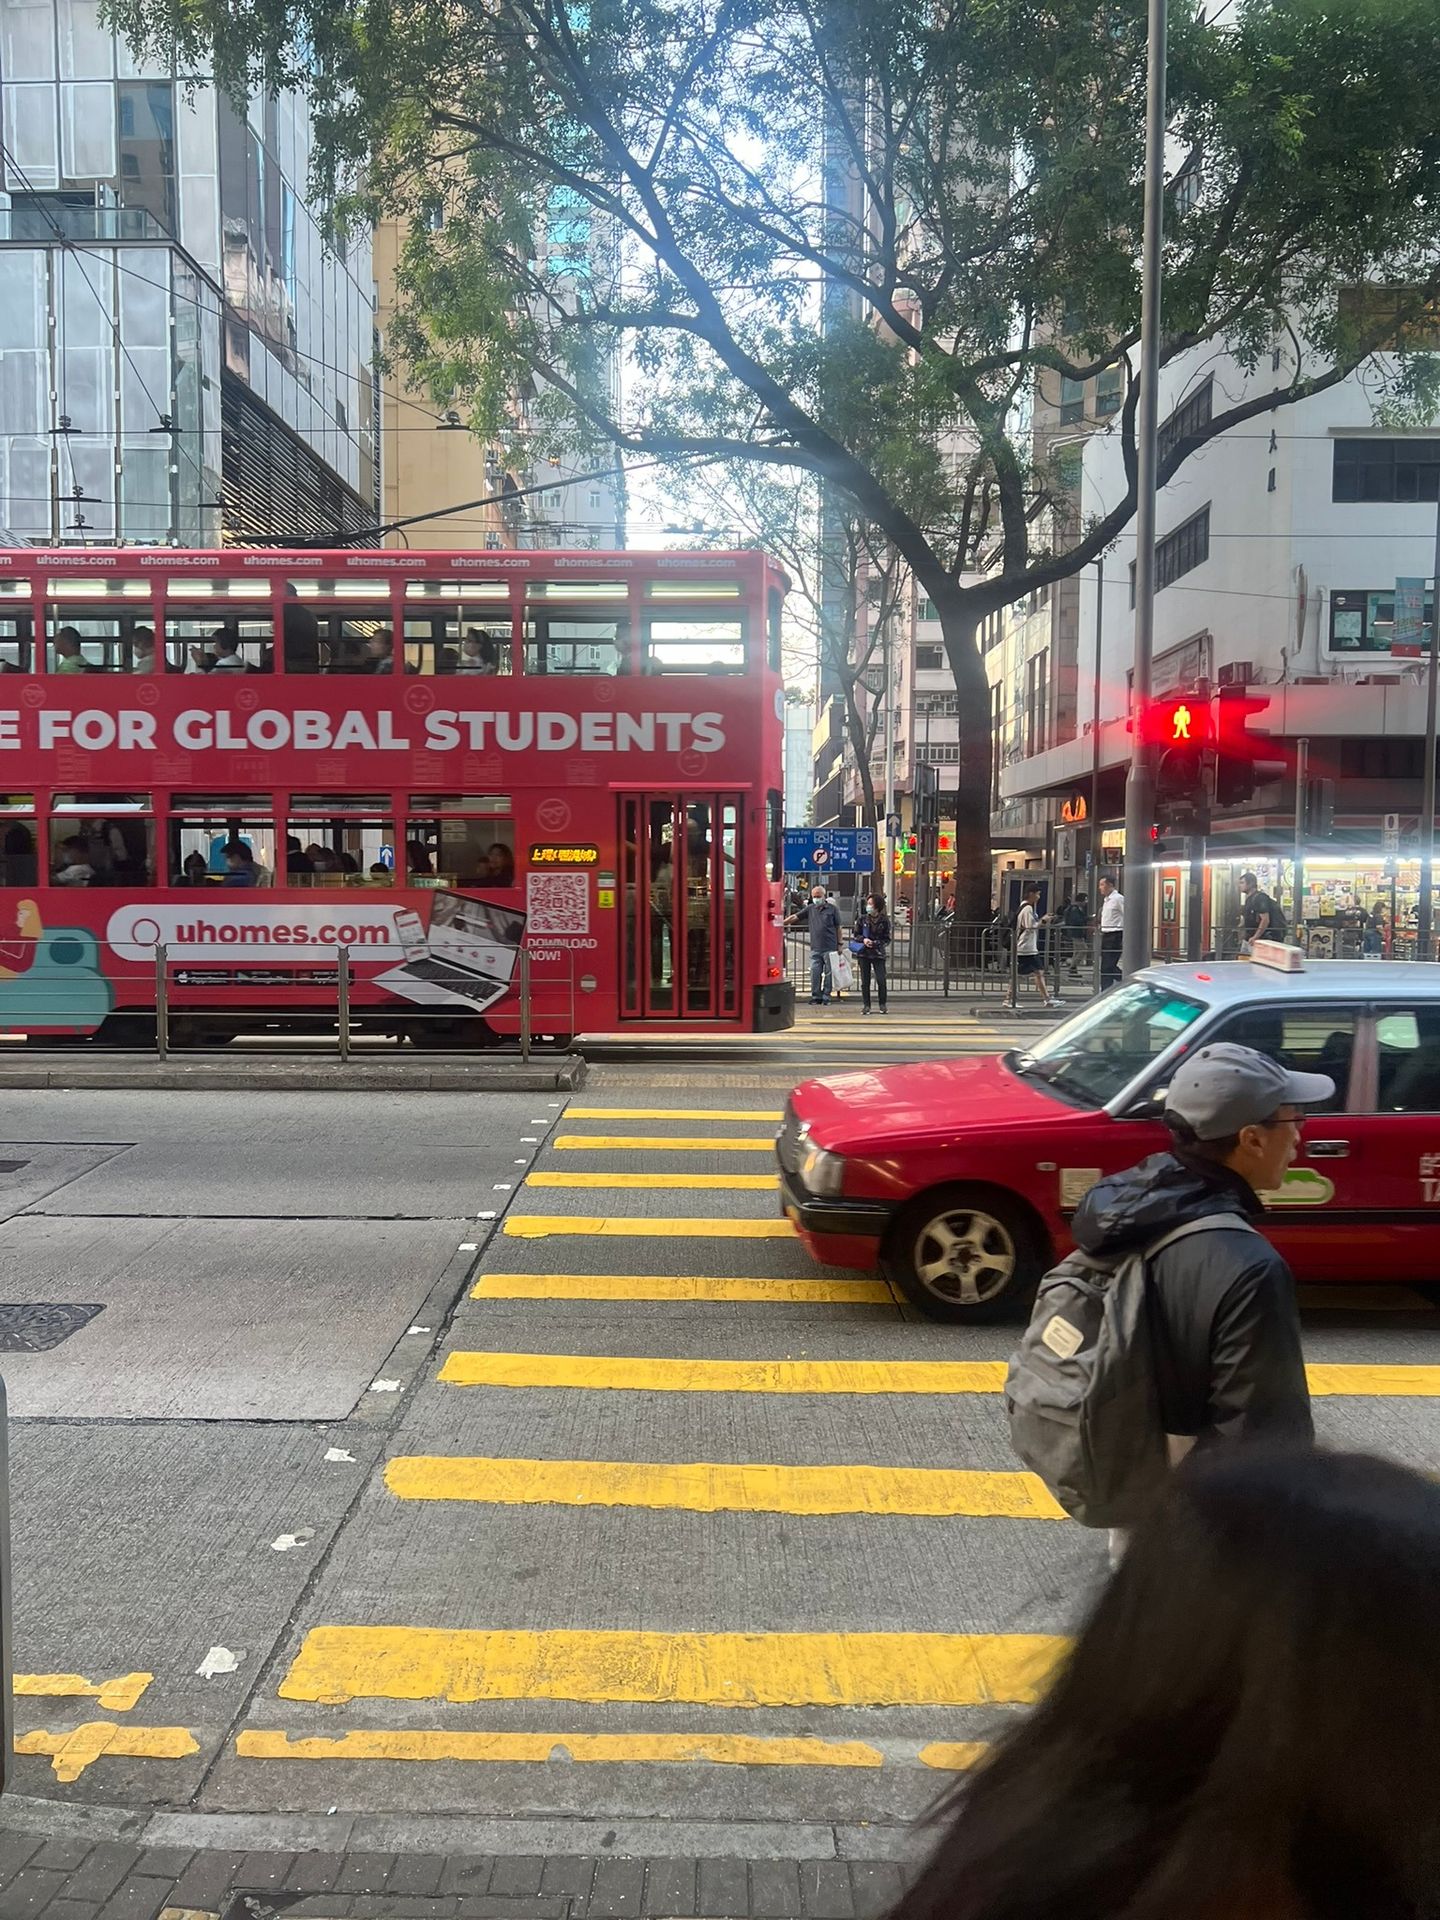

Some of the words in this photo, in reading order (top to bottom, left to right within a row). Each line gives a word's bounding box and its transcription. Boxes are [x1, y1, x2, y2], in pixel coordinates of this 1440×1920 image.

[37, 555, 117, 566] uhomes.com
[141, 555, 220, 566] uhomes.com
[244, 555, 323, 566] uhomes.com
[347, 556, 427, 567] uhomes.com
[451, 556, 530, 568] uhomes.com
[554, 557, 633, 568] uhomes.com
[657, 558, 736, 568] uhomes.com
[39, 710, 157, 750] FOR
[173, 710, 410, 750] GLOBAL
[425, 710, 726, 753] STUDENTS
[176, 920, 390, 944] uhomes.com
[527, 938, 598, 949] DOWNLOAD
[528, 951, 561, 961] NOW!
